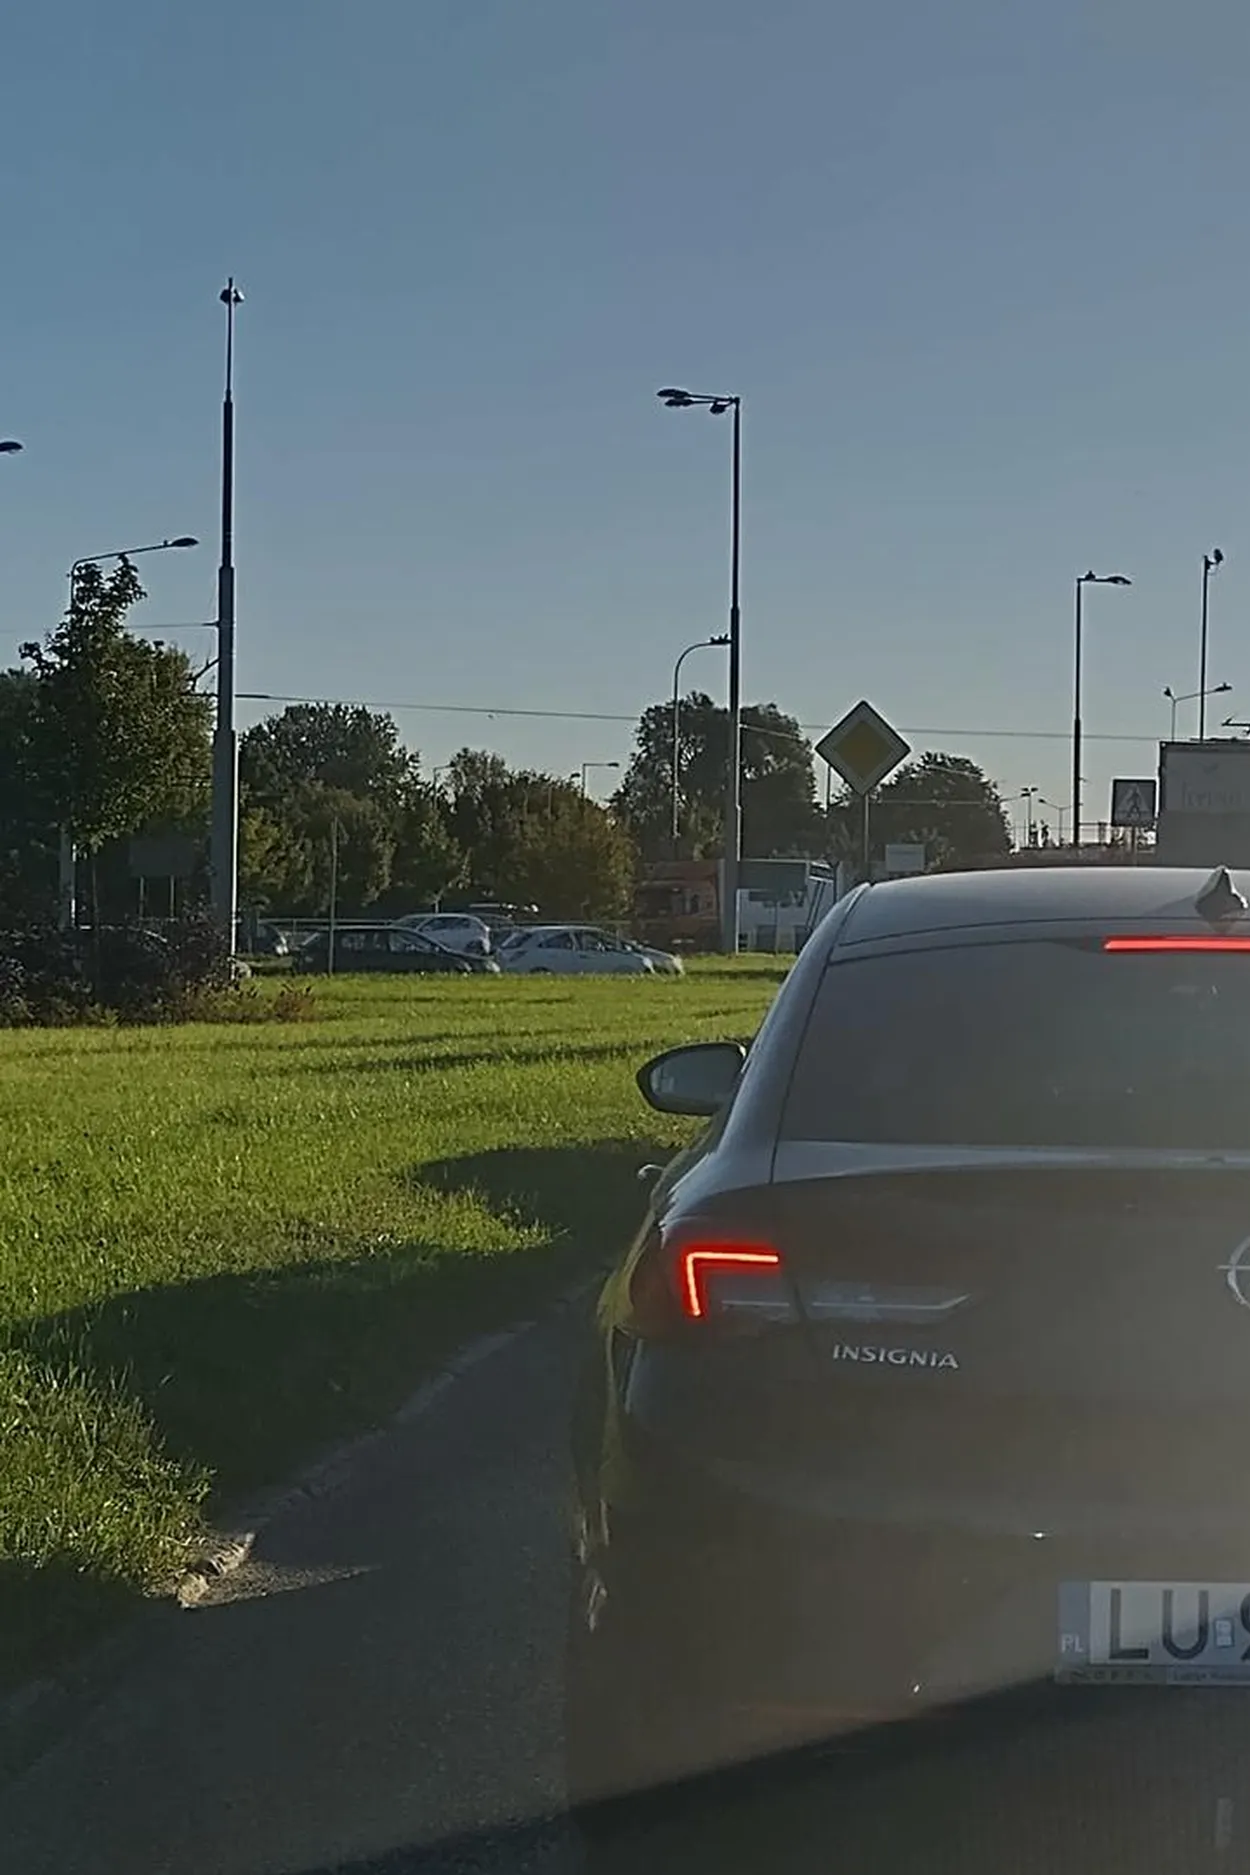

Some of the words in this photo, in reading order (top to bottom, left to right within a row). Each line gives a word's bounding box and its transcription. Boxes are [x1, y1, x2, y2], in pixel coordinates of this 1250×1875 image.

[832, 1344, 960, 1369] INSIGNIA
[1107, 1588, 1209, 1660] LU
[1060, 1633, 1084, 1653] PL
